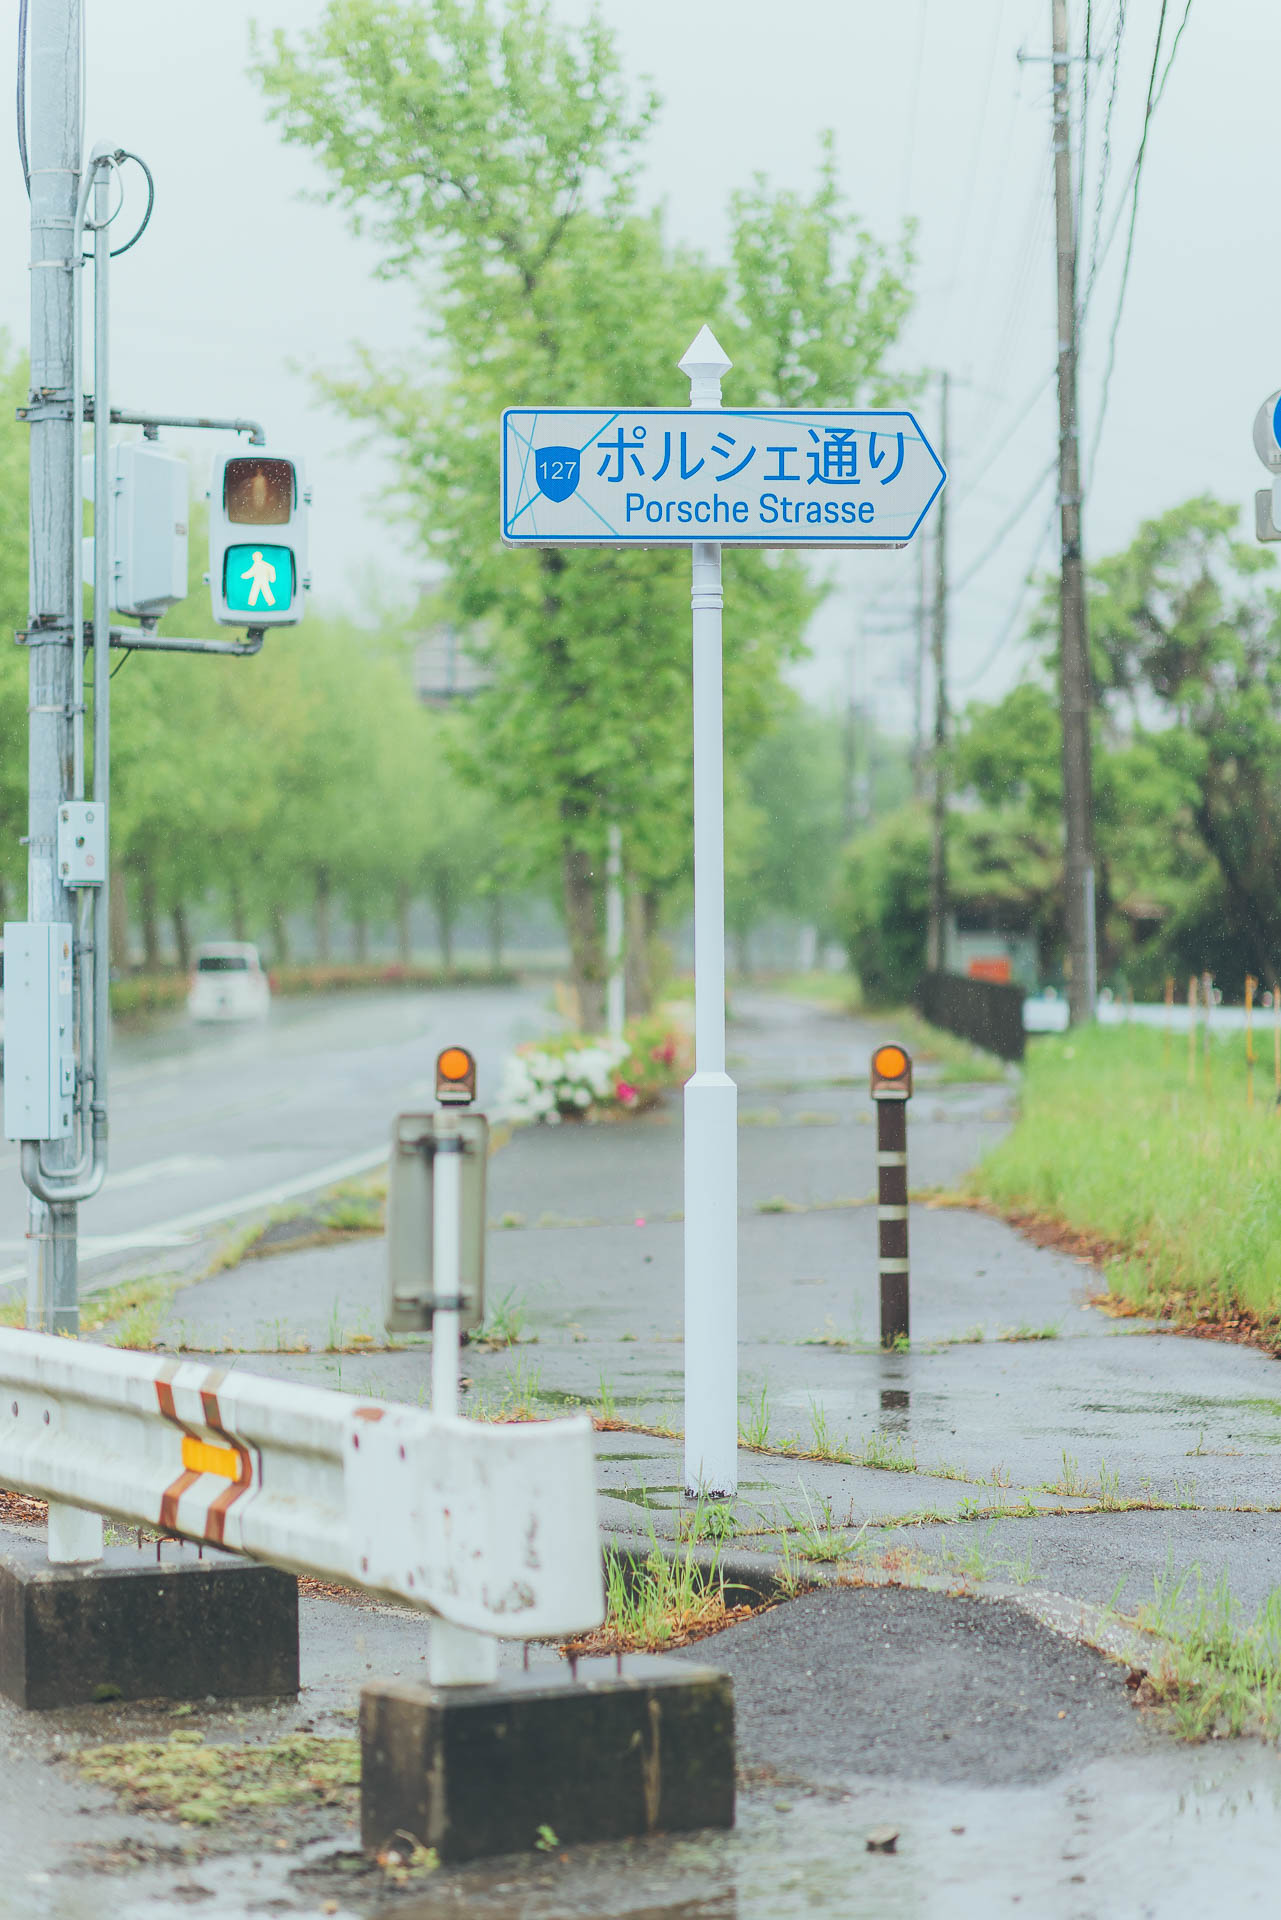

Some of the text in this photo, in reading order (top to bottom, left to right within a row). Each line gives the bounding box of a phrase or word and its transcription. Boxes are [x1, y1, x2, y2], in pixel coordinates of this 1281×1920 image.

[596, 425, 905, 485] ポルシェ通り
[539, 461, 577, 481] 127
[626, 493, 875, 523] Porsche Strasse
